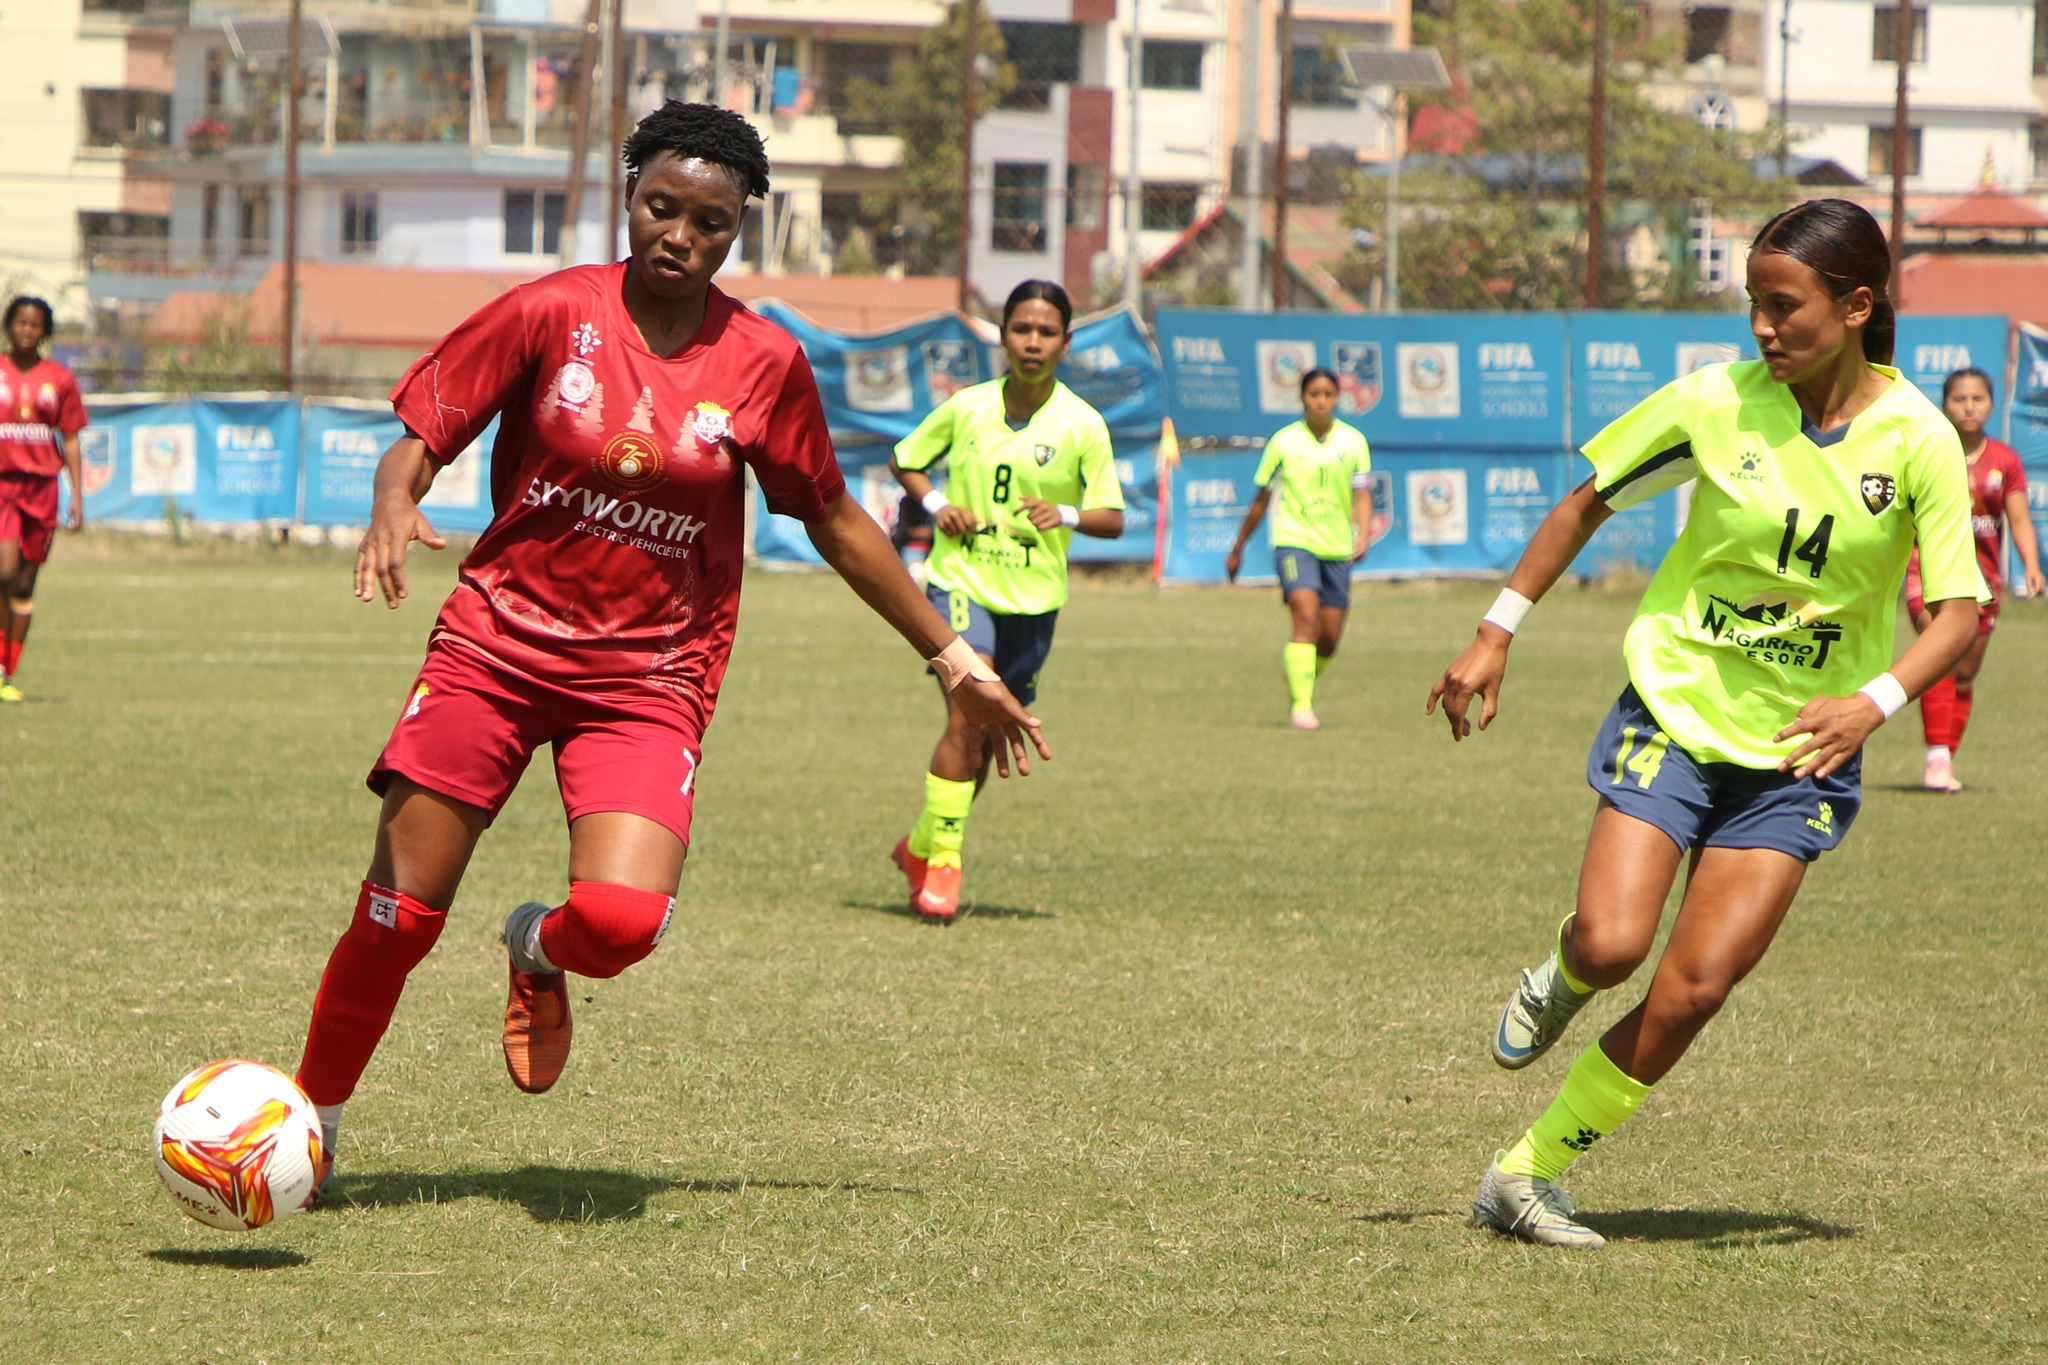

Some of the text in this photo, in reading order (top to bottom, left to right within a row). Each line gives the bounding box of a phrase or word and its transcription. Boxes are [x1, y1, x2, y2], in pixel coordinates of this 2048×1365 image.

[1173, 336, 1226, 362] FIFA
[1479, 342, 1534, 370] FIFA
[1586, 341, 1641, 370] FIFA
[1915, 344, 1971, 372] FIFA
[217, 424, 274, 450] FIFA
[322, 429, 380, 455] FIFA
[993, 464, 1011, 503] 8
[1486, 467, 1540, 495] FIFA
[1730, 472, 1765, 483] KELME
[1185, 479, 1238, 506] FIFA
[522, 477, 706, 543] SKYWORTH
[574, 520, 629, 545] ELECTRIC
[1777, 507, 1835, 578] 14
[949, 592, 970, 632] 8
[1700, 600, 1842, 670] NAGARKOT
[1612, 726, 1670, 790] 14
